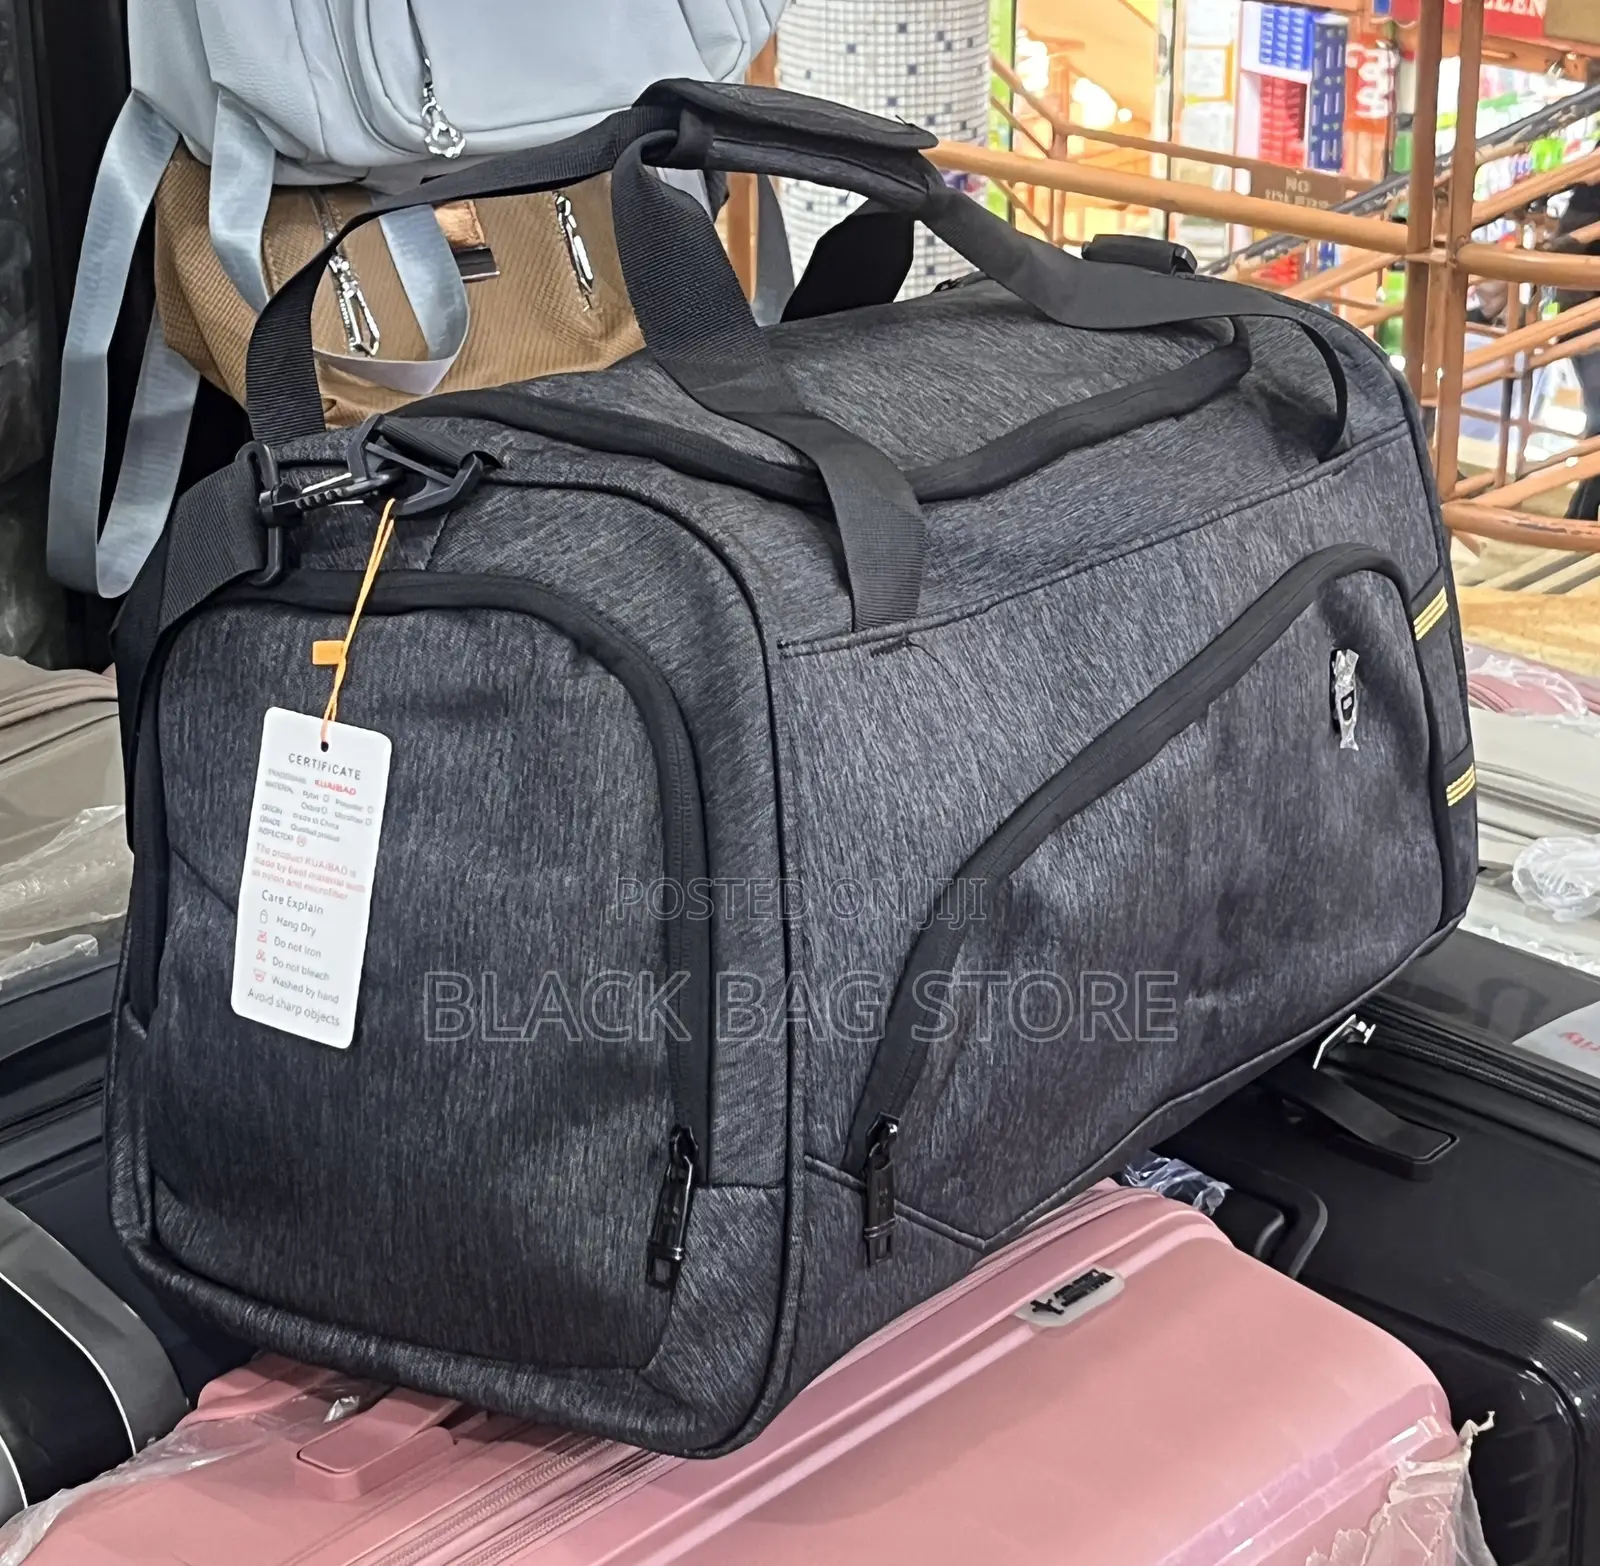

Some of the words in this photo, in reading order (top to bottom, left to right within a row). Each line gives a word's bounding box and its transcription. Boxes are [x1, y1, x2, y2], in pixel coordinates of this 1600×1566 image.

[1286, 176, 1310, 193] NO
[288, 753, 362, 781] CERTIFICATE
[320, 818, 339, 831] China
[276, 862, 286, 874] by
[261, 889, 285, 905] Care
[286, 896, 324, 915] Explain
[276, 915, 299, 932] Hang
[300, 922, 317, 937] Dry
[273, 936, 287, 948] Do
[287, 941, 303, 953] not
[304, 946, 322, 959] iron
[272, 956, 284, 968] Do
[285, 961, 300, 973] not
[301, 965, 330, 981] bleach
[271, 975, 304, 993] Washed
[305, 985, 316, 999] by
[317, 990, 340, 1004] hand
[247, 987, 274, 1006] Avoid
[275, 997, 303, 1016] sharp
[303, 1008, 340, 1027] objects
